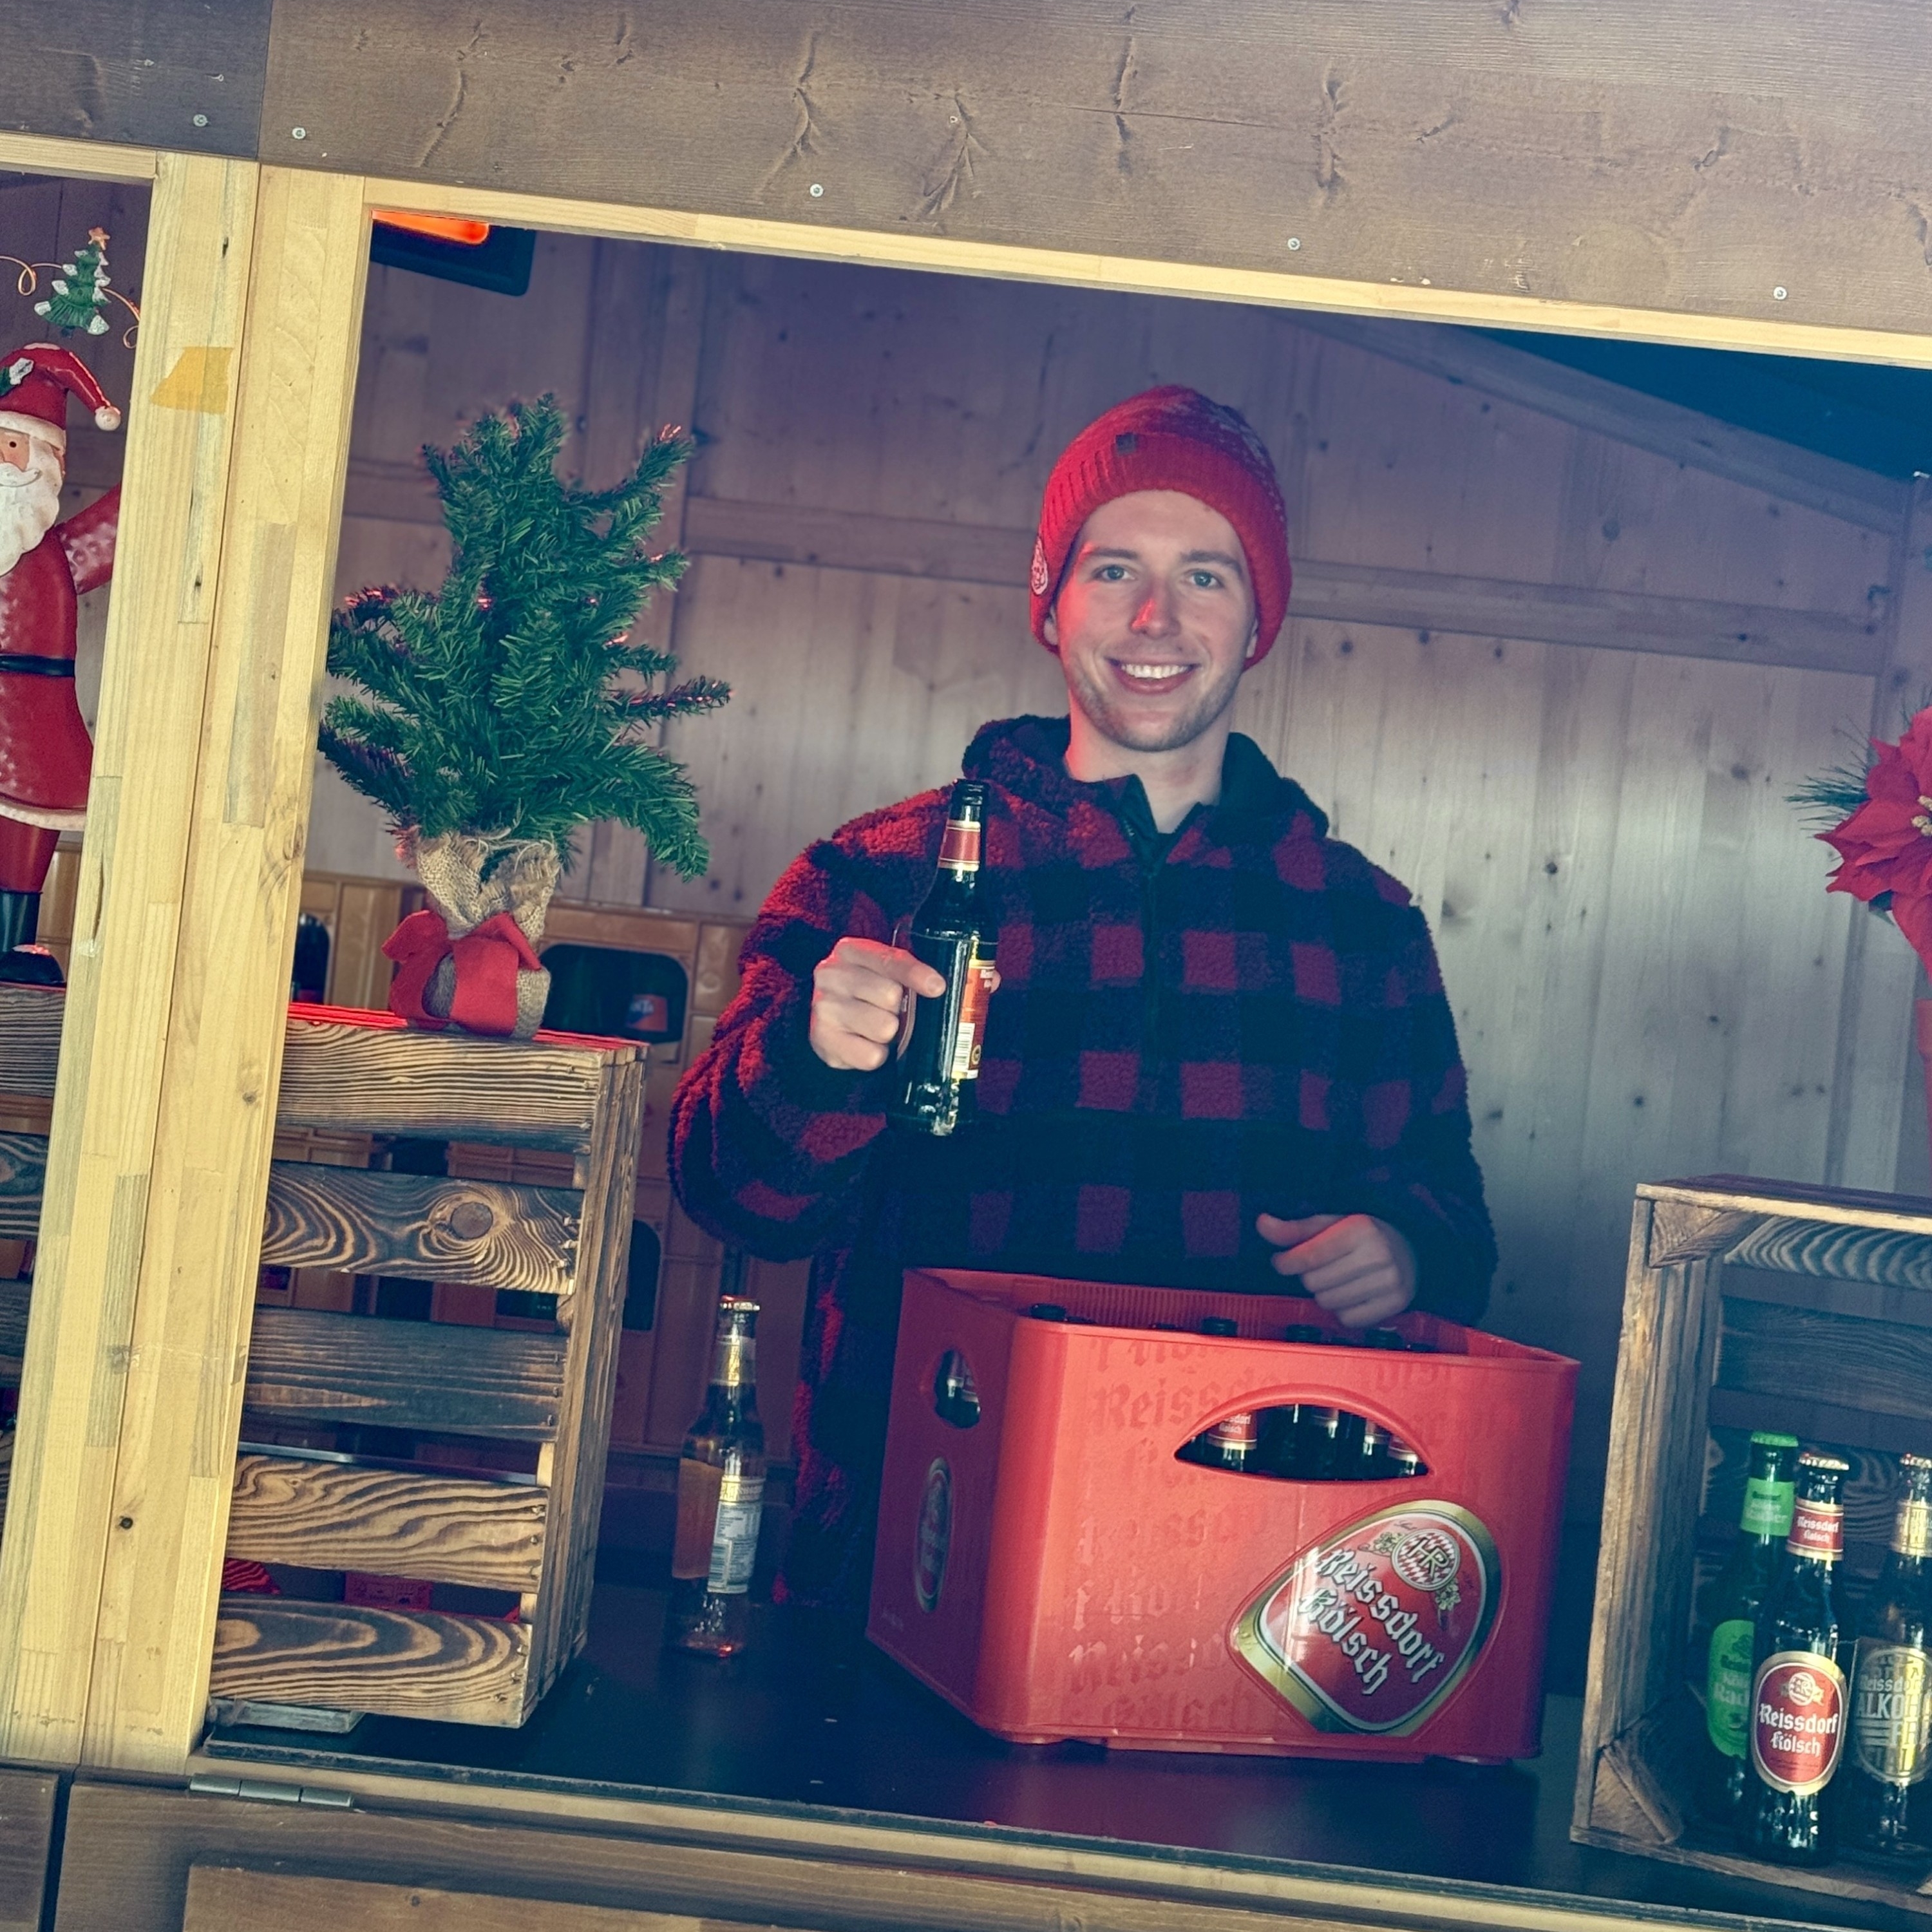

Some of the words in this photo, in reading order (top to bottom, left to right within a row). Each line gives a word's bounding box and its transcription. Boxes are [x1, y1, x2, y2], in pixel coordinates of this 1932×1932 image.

[1797, 1515, 1839, 1534] Reissdorf
[1313, 1548, 1445, 1683] Reissdorf
[1298, 1587, 1392, 1695] Kölsch
[1759, 1703, 1839, 1734] Reissdorf
[1857, 1690, 1932, 1722] ALKOHO
[1770, 1730, 1821, 1757] Kölsch
